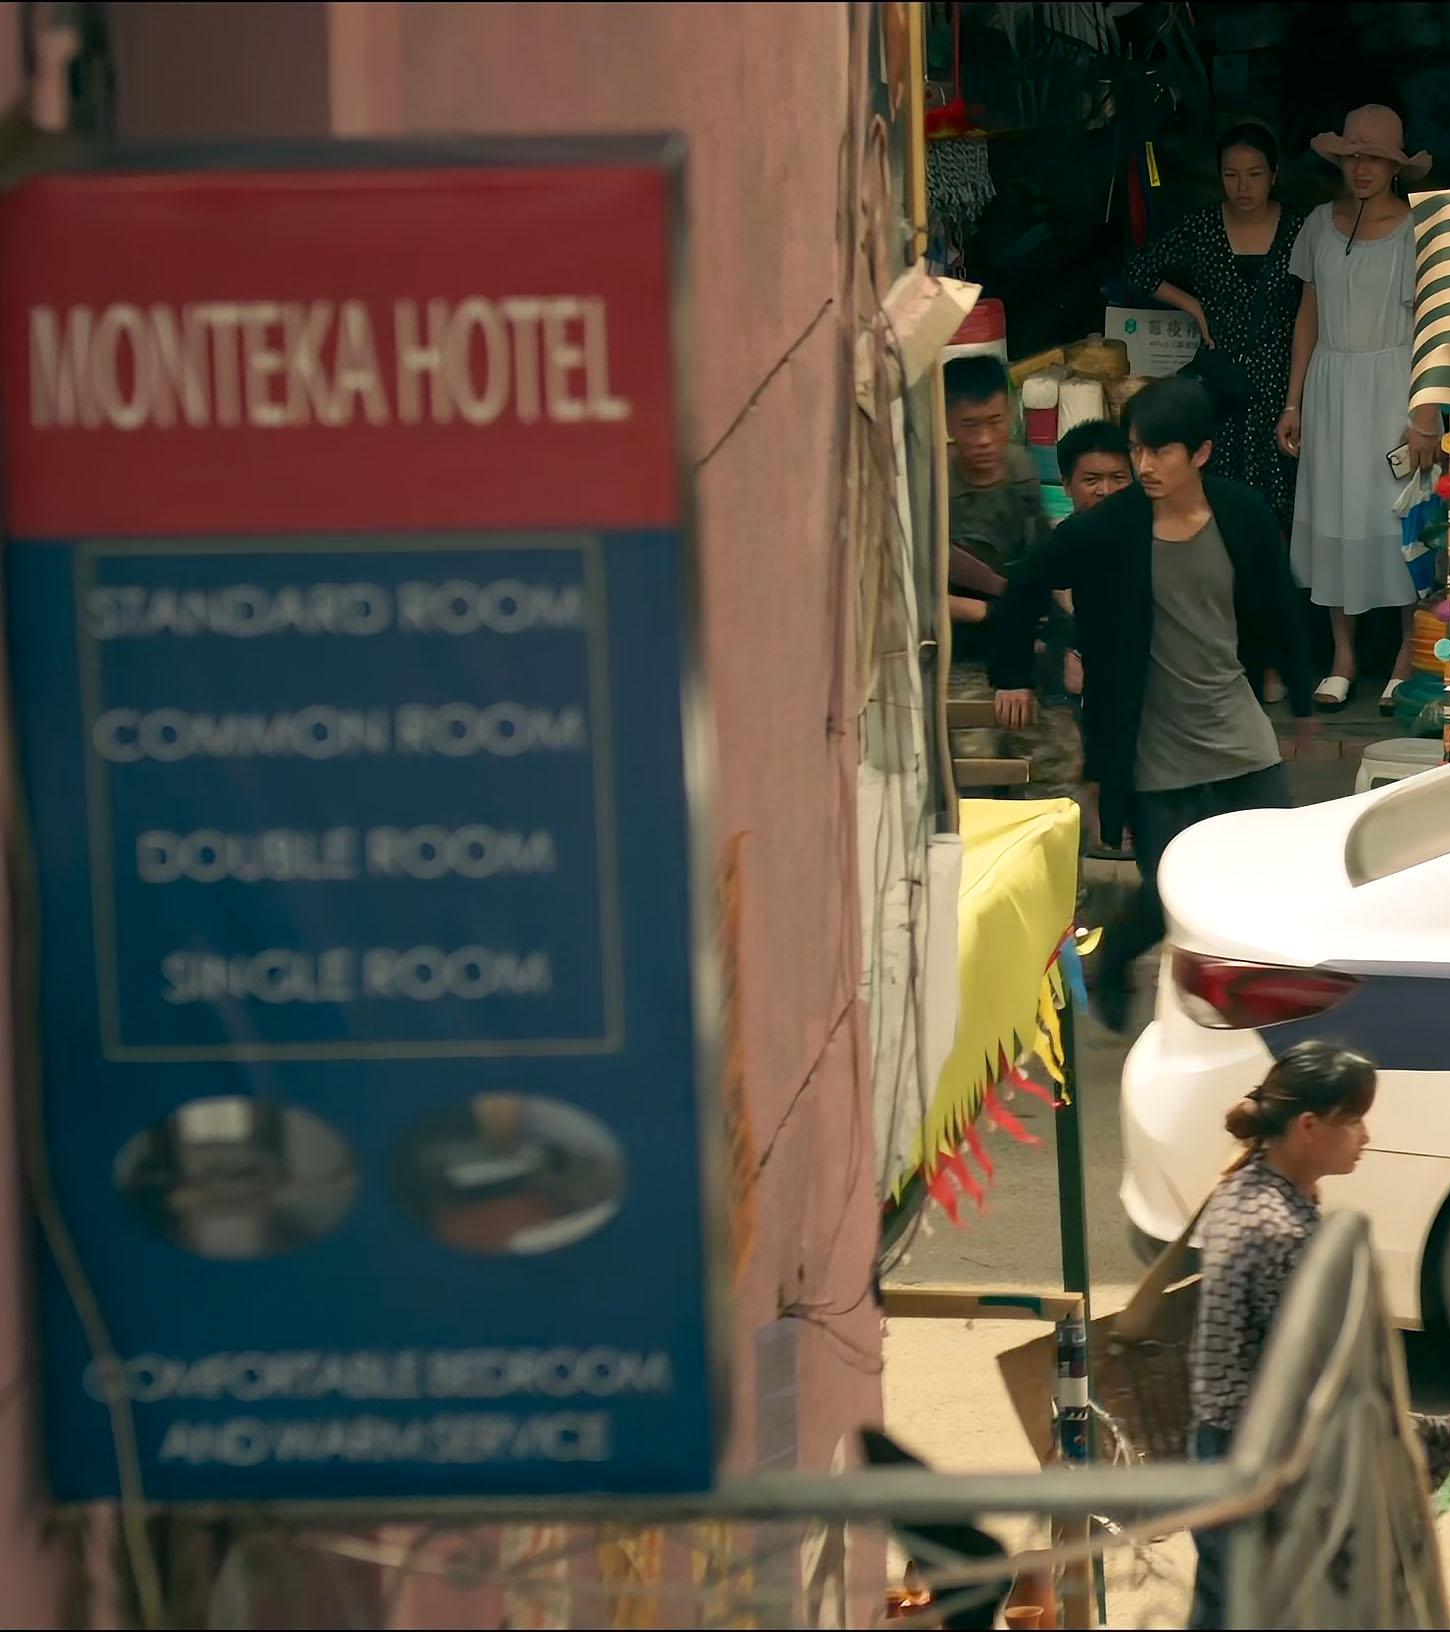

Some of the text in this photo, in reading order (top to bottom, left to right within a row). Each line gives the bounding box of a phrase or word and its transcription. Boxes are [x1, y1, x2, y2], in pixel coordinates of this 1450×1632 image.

[28, 295, 630, 430] MONTEKA HOTEL
[87, 579, 582, 640] STANDARD ROOM
[93, 701, 584, 763] COMMON ROOM
[136, 823, 557, 883] DOUBLE ROOM
[161, 945, 552, 1005] SINGLE ROOM
[423, 1345, 672, 1399] BEDROOM
[158, 1416, 272, 1467] AND
